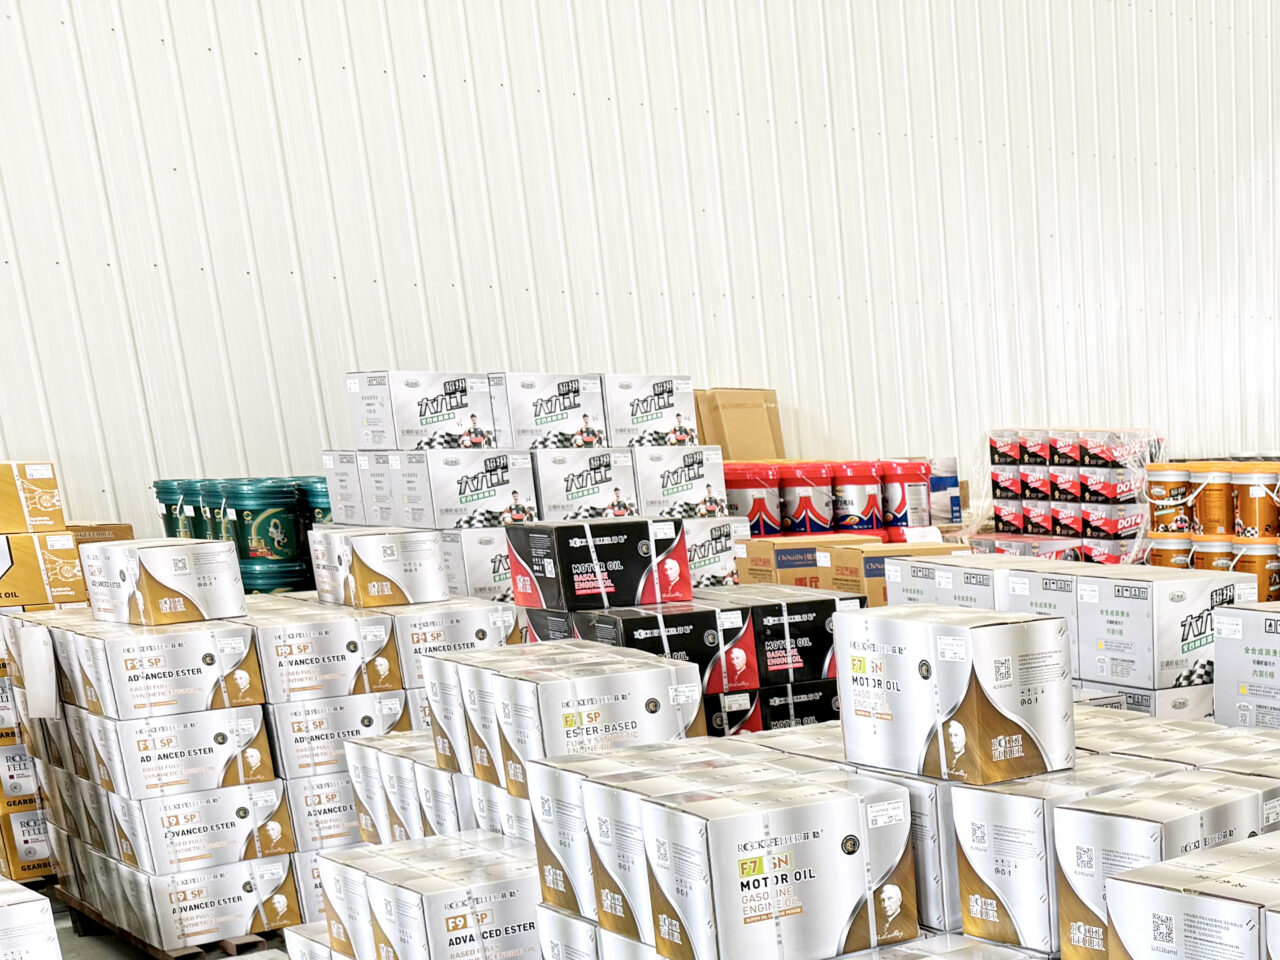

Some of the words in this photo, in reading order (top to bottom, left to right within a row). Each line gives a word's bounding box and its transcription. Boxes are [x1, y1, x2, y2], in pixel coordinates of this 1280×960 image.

[1118, 514, 1143, 529] DOT4
[607, 561, 623, 571] OIL
[1181, 609, 1215, 642] 大力
[453, 641, 476, 651] ESTER
[278, 656, 320, 668] AVANCED
[322, 654, 347, 664] ESTER
[175, 667, 202, 678] ESTER
[886, 680, 901, 692] OIL
[337, 729, 361, 738] ESTER
[140, 751, 185, 764] ADANCED
[187, 747, 214, 757] ESTER
[211, 821, 236, 832] ESTER
[741, 861, 758, 876] F7
[794, 868, 816, 882] OIL
[218, 896, 242, 907] ESTER
[741, 887, 793, 904] GASOINE
[449, 915, 464, 930] F9
[448, 929, 501, 947] ADVACED
[504, 922, 536, 936] ESTER
